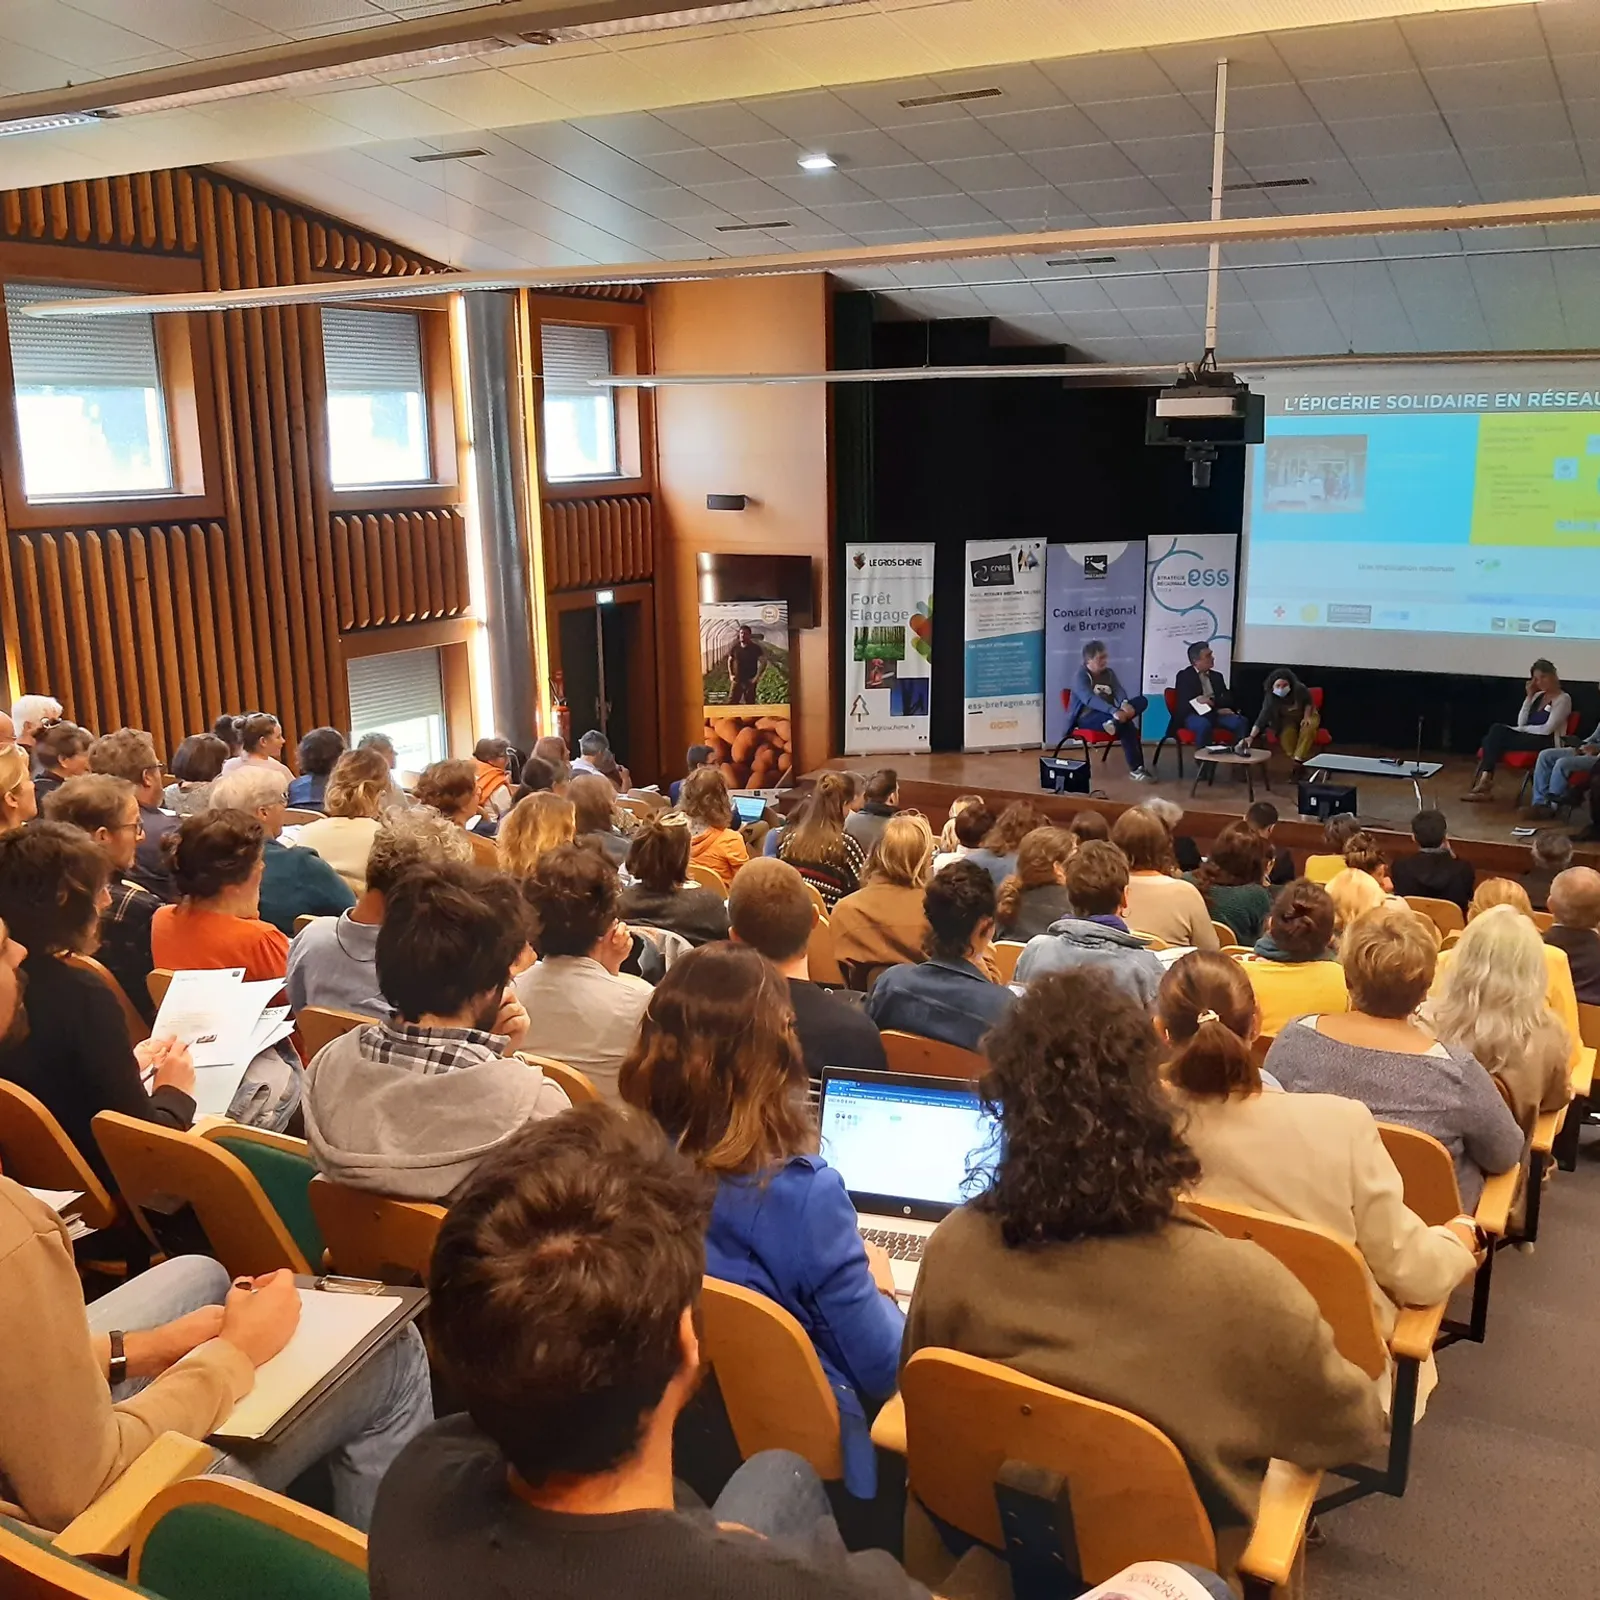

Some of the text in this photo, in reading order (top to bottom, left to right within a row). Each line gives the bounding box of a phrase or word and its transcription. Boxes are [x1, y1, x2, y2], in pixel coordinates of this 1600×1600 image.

[1386, 393, 1489, 409] SOLIDAIRE
[1495, 392, 1521, 407] EN
[869, 558, 877, 567] LE
[877, 558, 897, 567] GROS
[990, 564, 1011, 572] cress
[1187, 568, 1229, 587] ess
[850, 592, 892, 606] Forêt
[1053, 605, 1136, 618] Conseil régional
[1063, 621, 1126, 632] de Bretagne
[967, 698, 1041, 710] ess-bretagne.org
